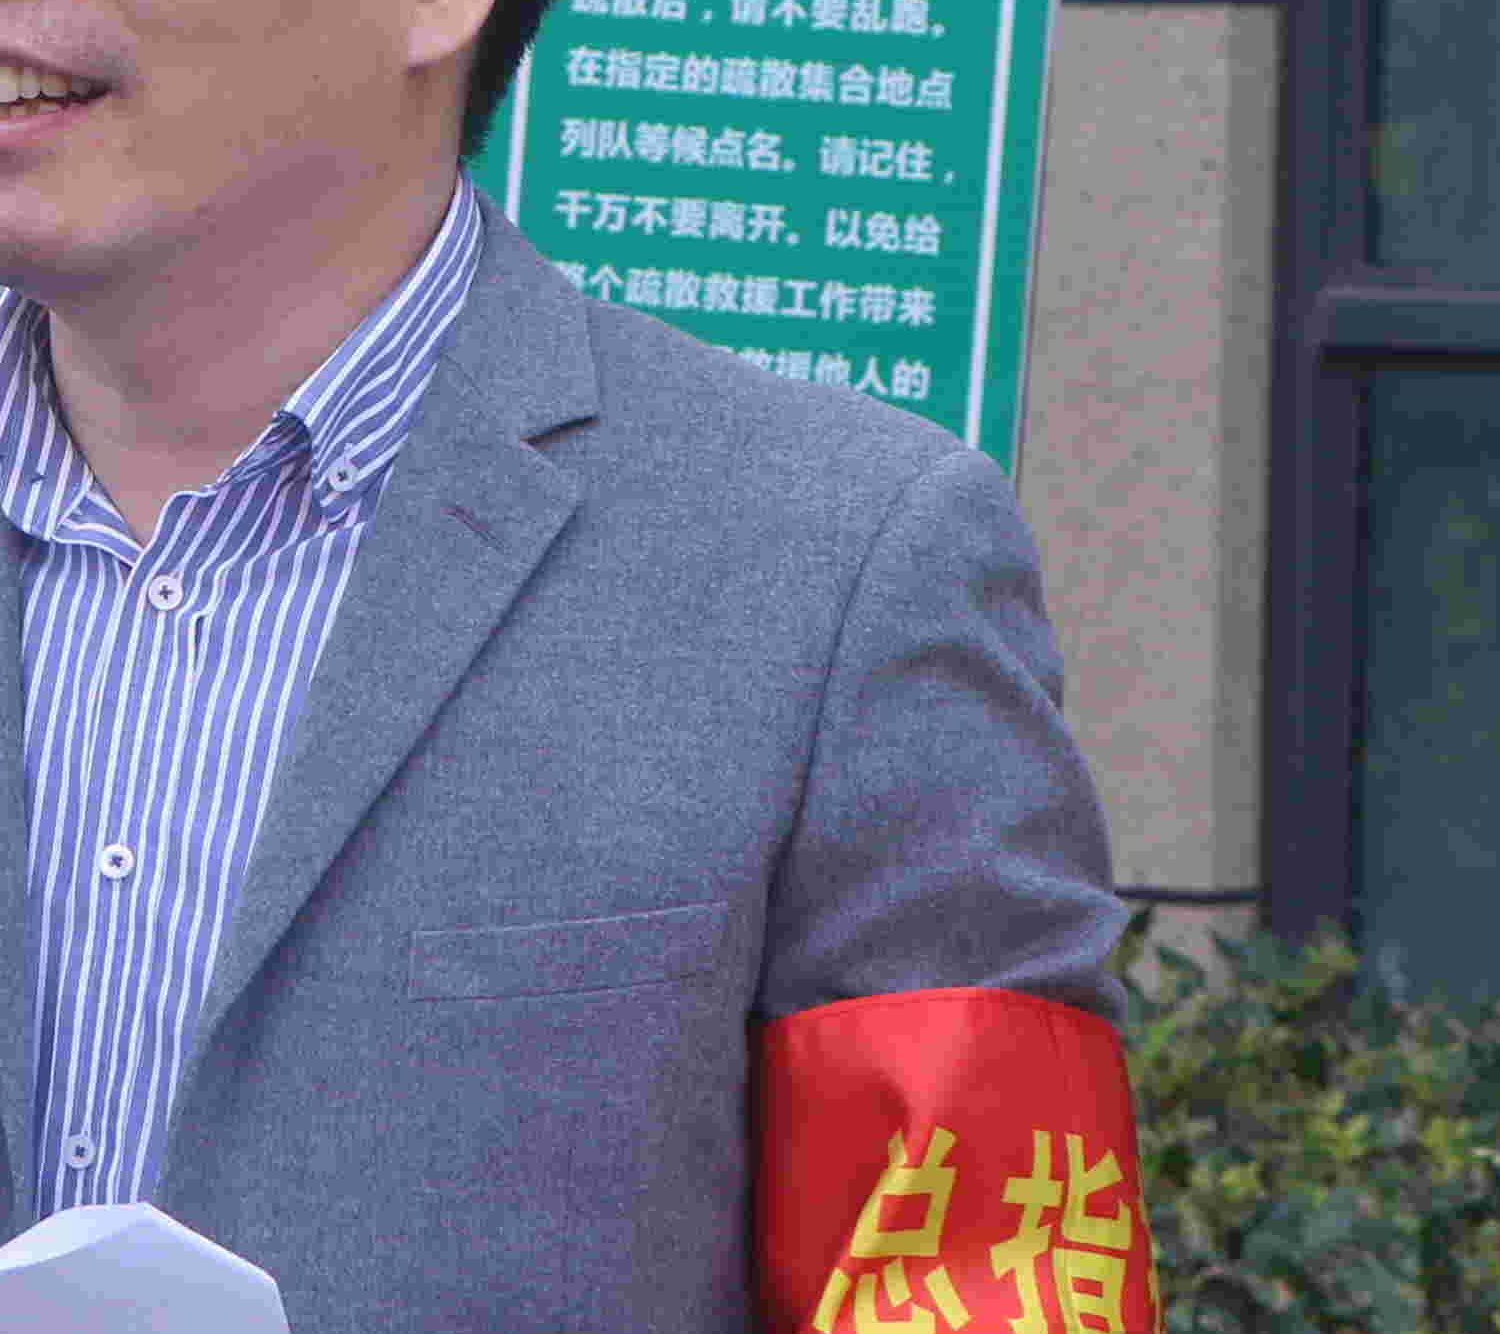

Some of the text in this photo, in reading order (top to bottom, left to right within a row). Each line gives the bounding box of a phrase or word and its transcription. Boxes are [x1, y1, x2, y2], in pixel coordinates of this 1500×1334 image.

[566, 45, 955, 110] 在指定的疏散集合地点
